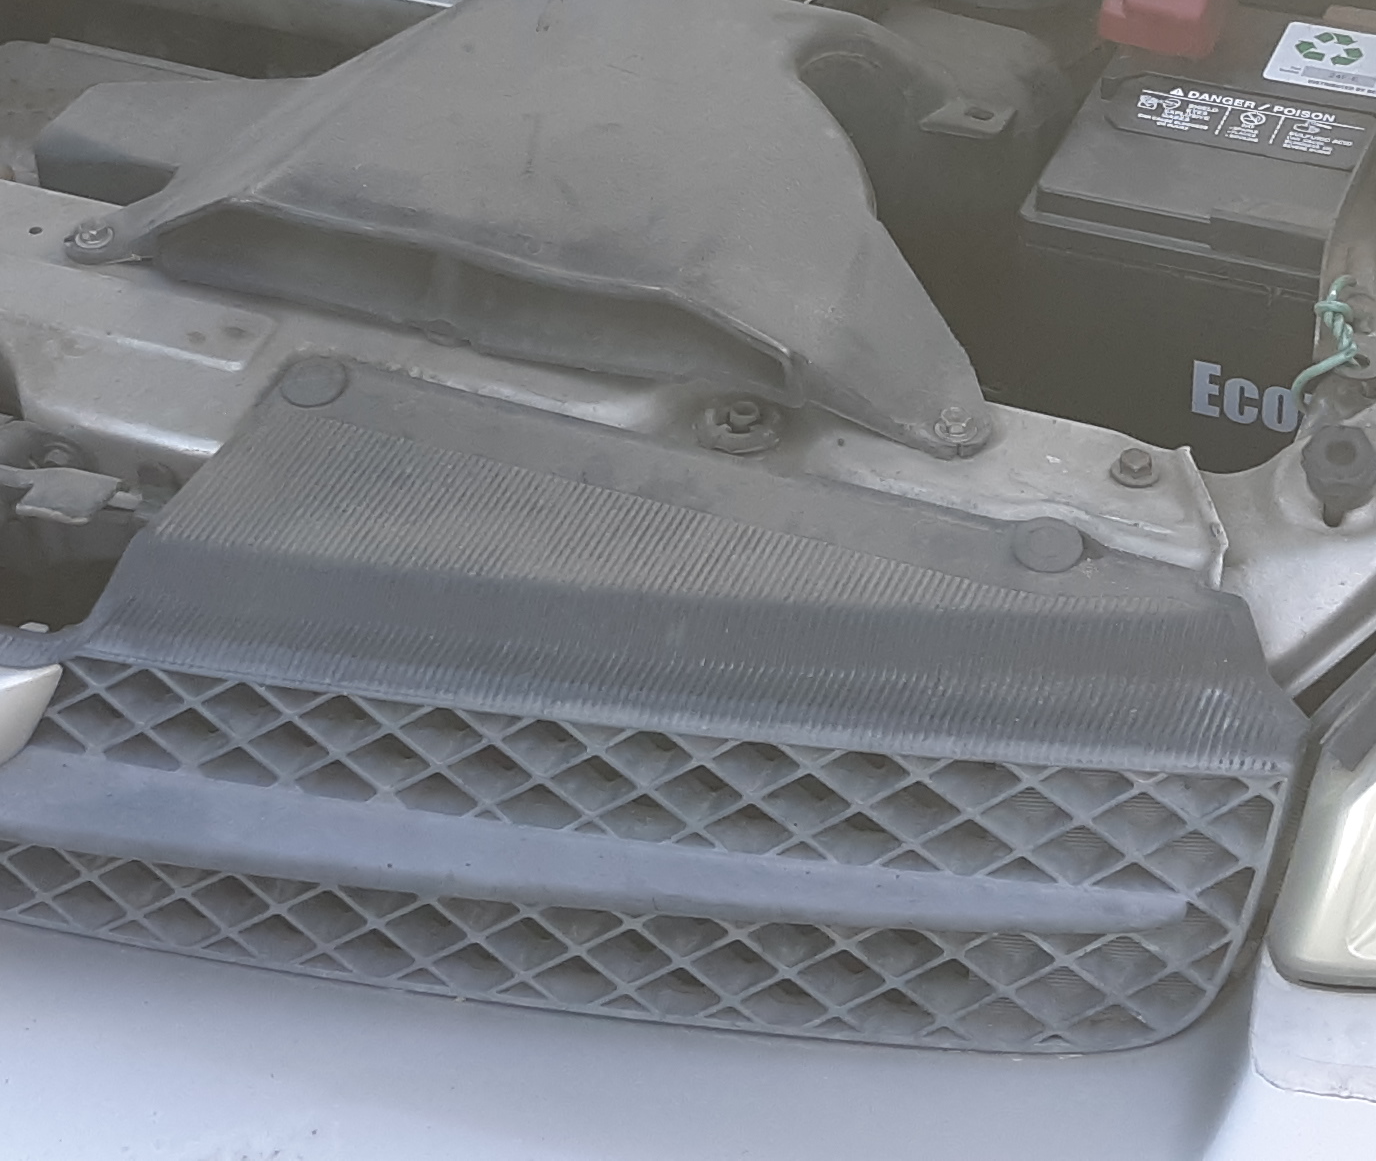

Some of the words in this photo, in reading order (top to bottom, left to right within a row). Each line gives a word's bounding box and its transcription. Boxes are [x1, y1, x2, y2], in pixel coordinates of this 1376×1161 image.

[1187, 90, 1257, 110] DANGER
[1273, 104, 1336, 123] POISON
[1190, 359, 1314, 433] Eco
